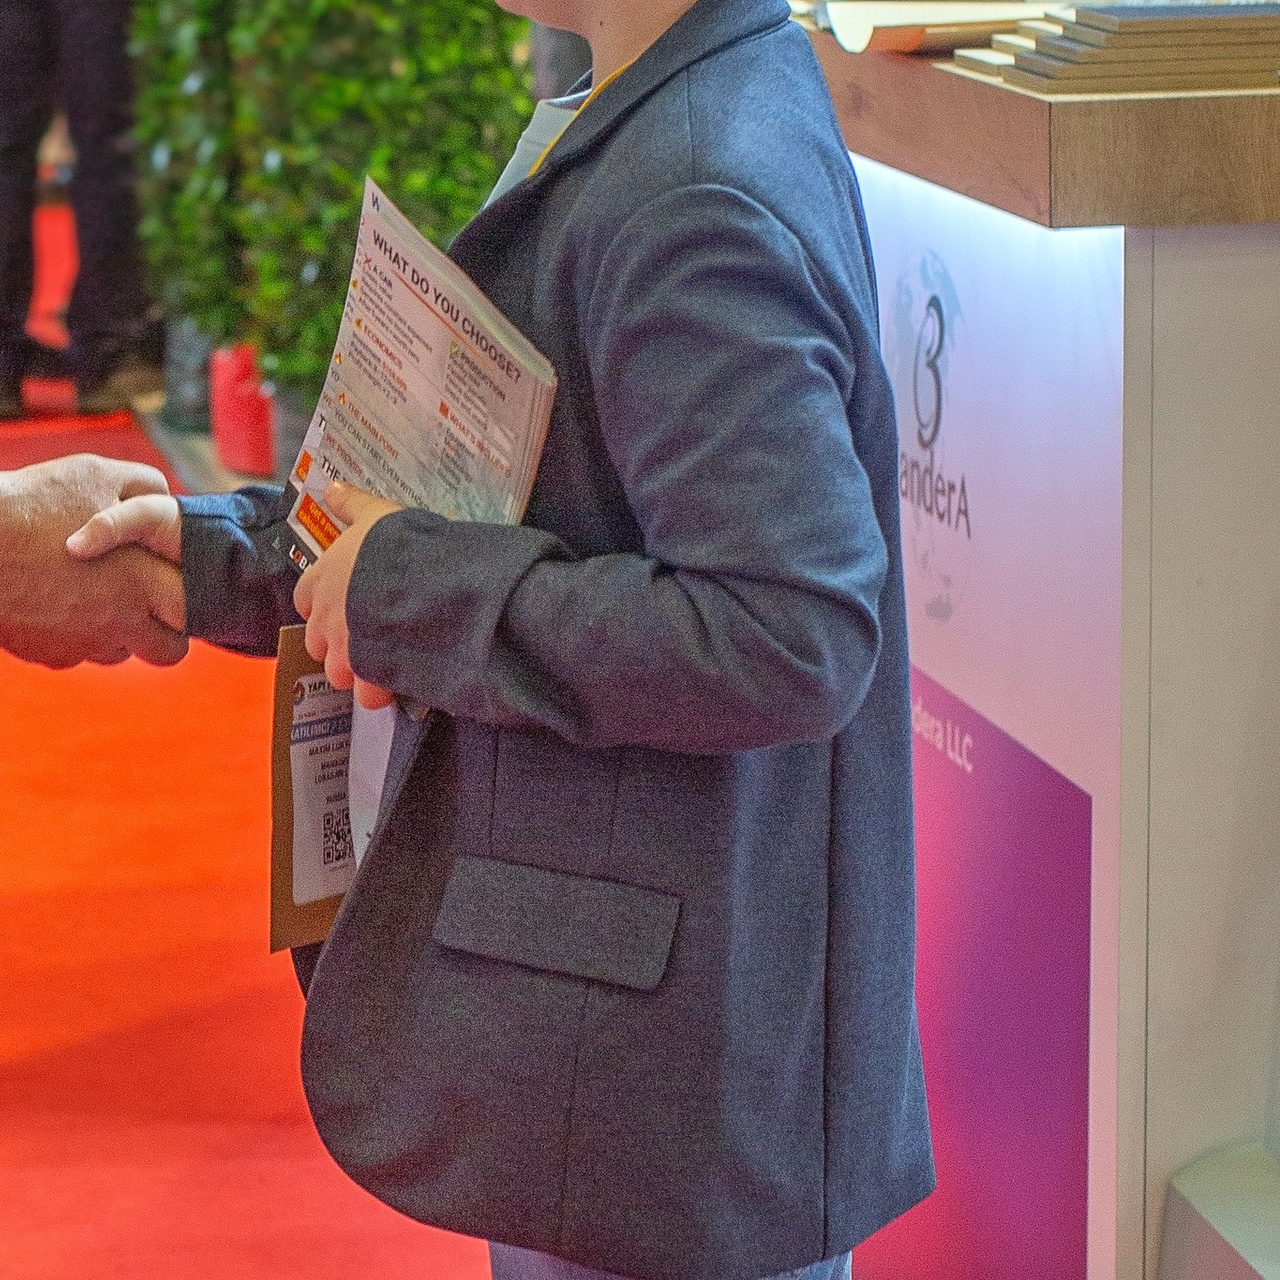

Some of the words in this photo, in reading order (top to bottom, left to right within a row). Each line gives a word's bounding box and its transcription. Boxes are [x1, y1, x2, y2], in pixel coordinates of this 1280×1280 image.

[372, 230, 409, 275] WHAT
[411, 267, 430, 295] DO
[432, 287, 460, 322] YOU
[461, 315, 521, 383] CHOOSE?
[362, 324, 403, 371] ECONOMICS
[333, 408, 347, 428] YOU
[347, 422, 361, 443] CAN
[361, 438, 382, 465] START
[381, 458, 400, 484] EVEN
[347, 400, 360, 420] THE
[360, 414, 379, 439] MAIN
[378, 433, 399, 461] POINT
